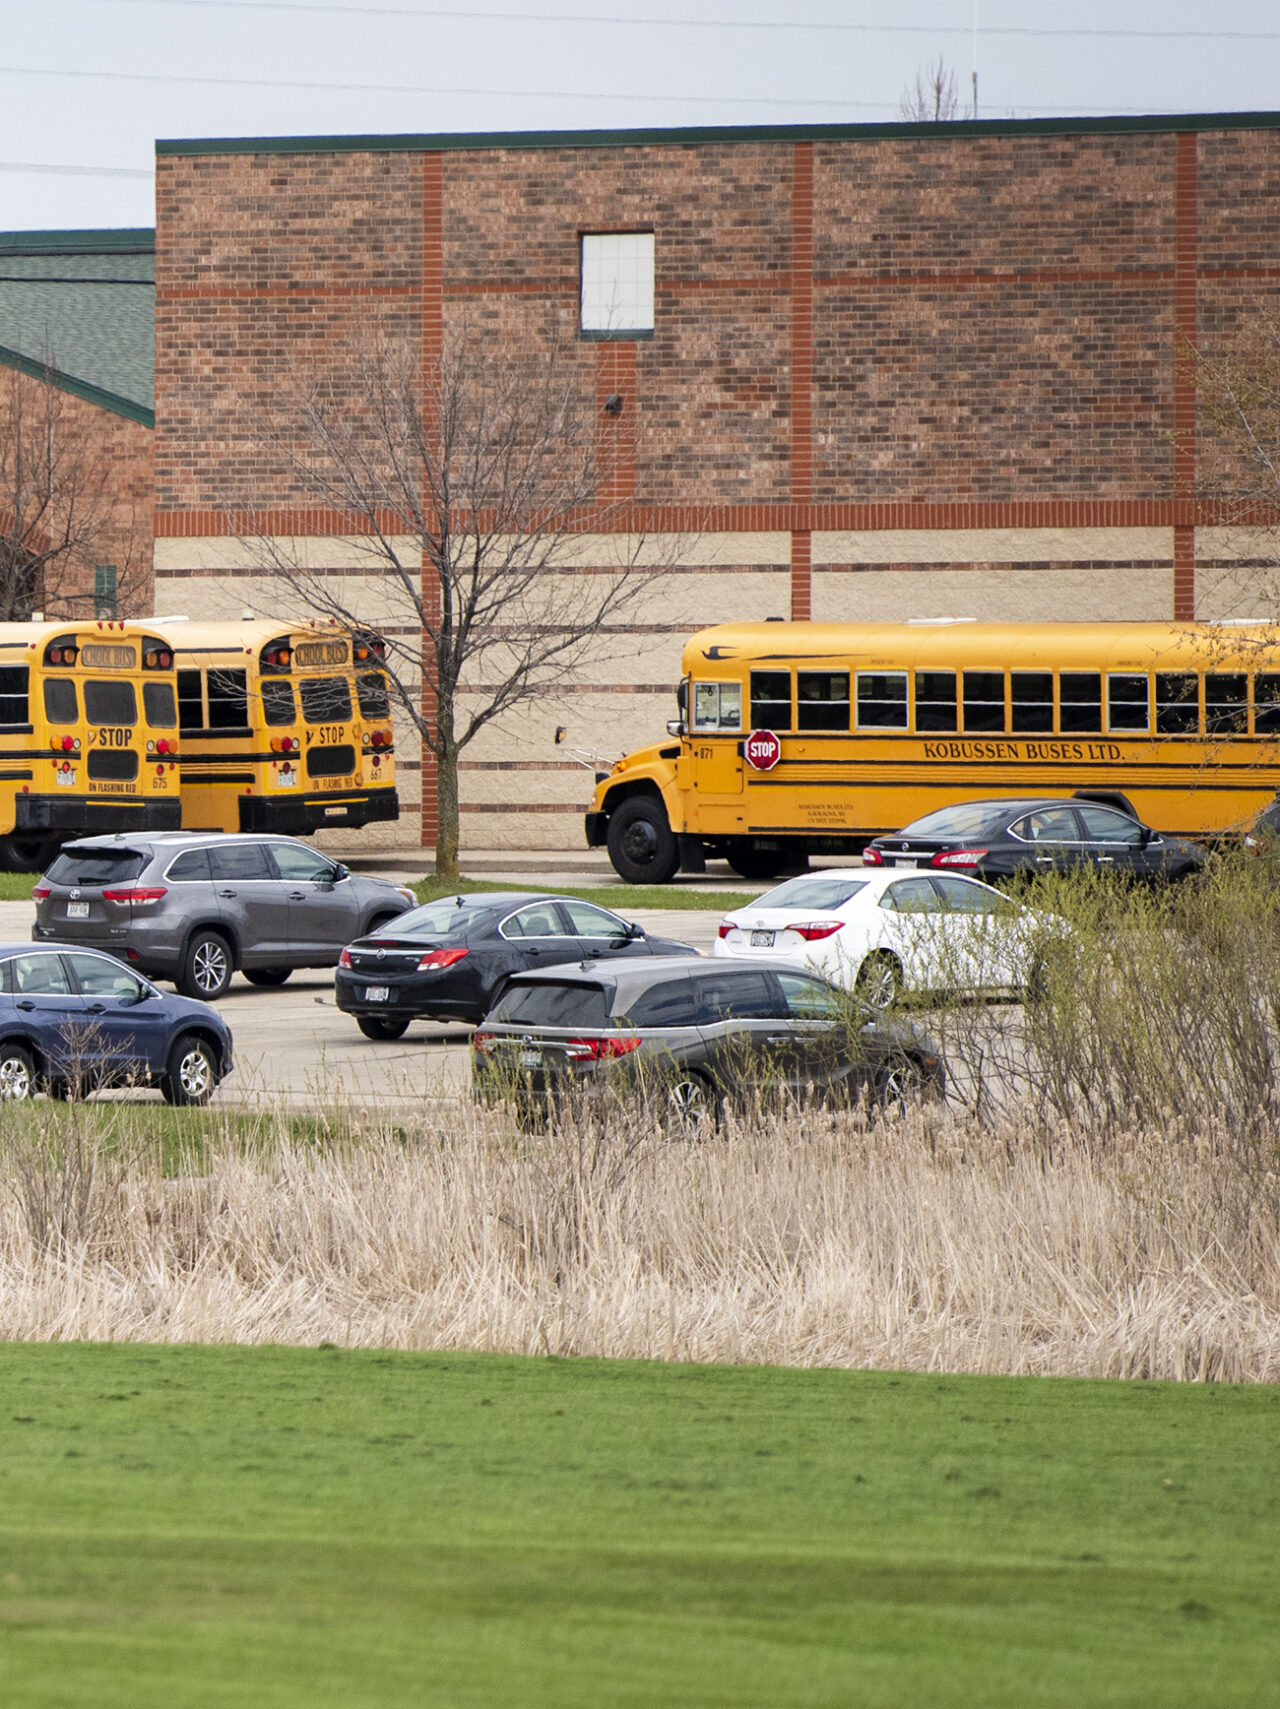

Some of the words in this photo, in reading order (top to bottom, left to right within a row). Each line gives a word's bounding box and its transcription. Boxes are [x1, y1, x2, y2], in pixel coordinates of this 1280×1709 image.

[99, 728, 132, 747] STOP
[320, 726, 344, 744] STOP
[700, 747, 713, 760] 871
[750, 742, 776, 758] STOP
[923, 742, 1019, 759] KOBUSSEN
[1026, 743, 1083, 760] BUSES
[1088, 744, 1126, 761] LTD.
[370, 768, 382, 781] 667
[89, 782, 97, 792] ON
[98, 783, 124, 793] FLASHING
[125, 784, 136, 793] RED
[153, 777, 167, 789] 675
[313, 780, 320, 790] ON
[323, 778, 342, 789] FLASHING
